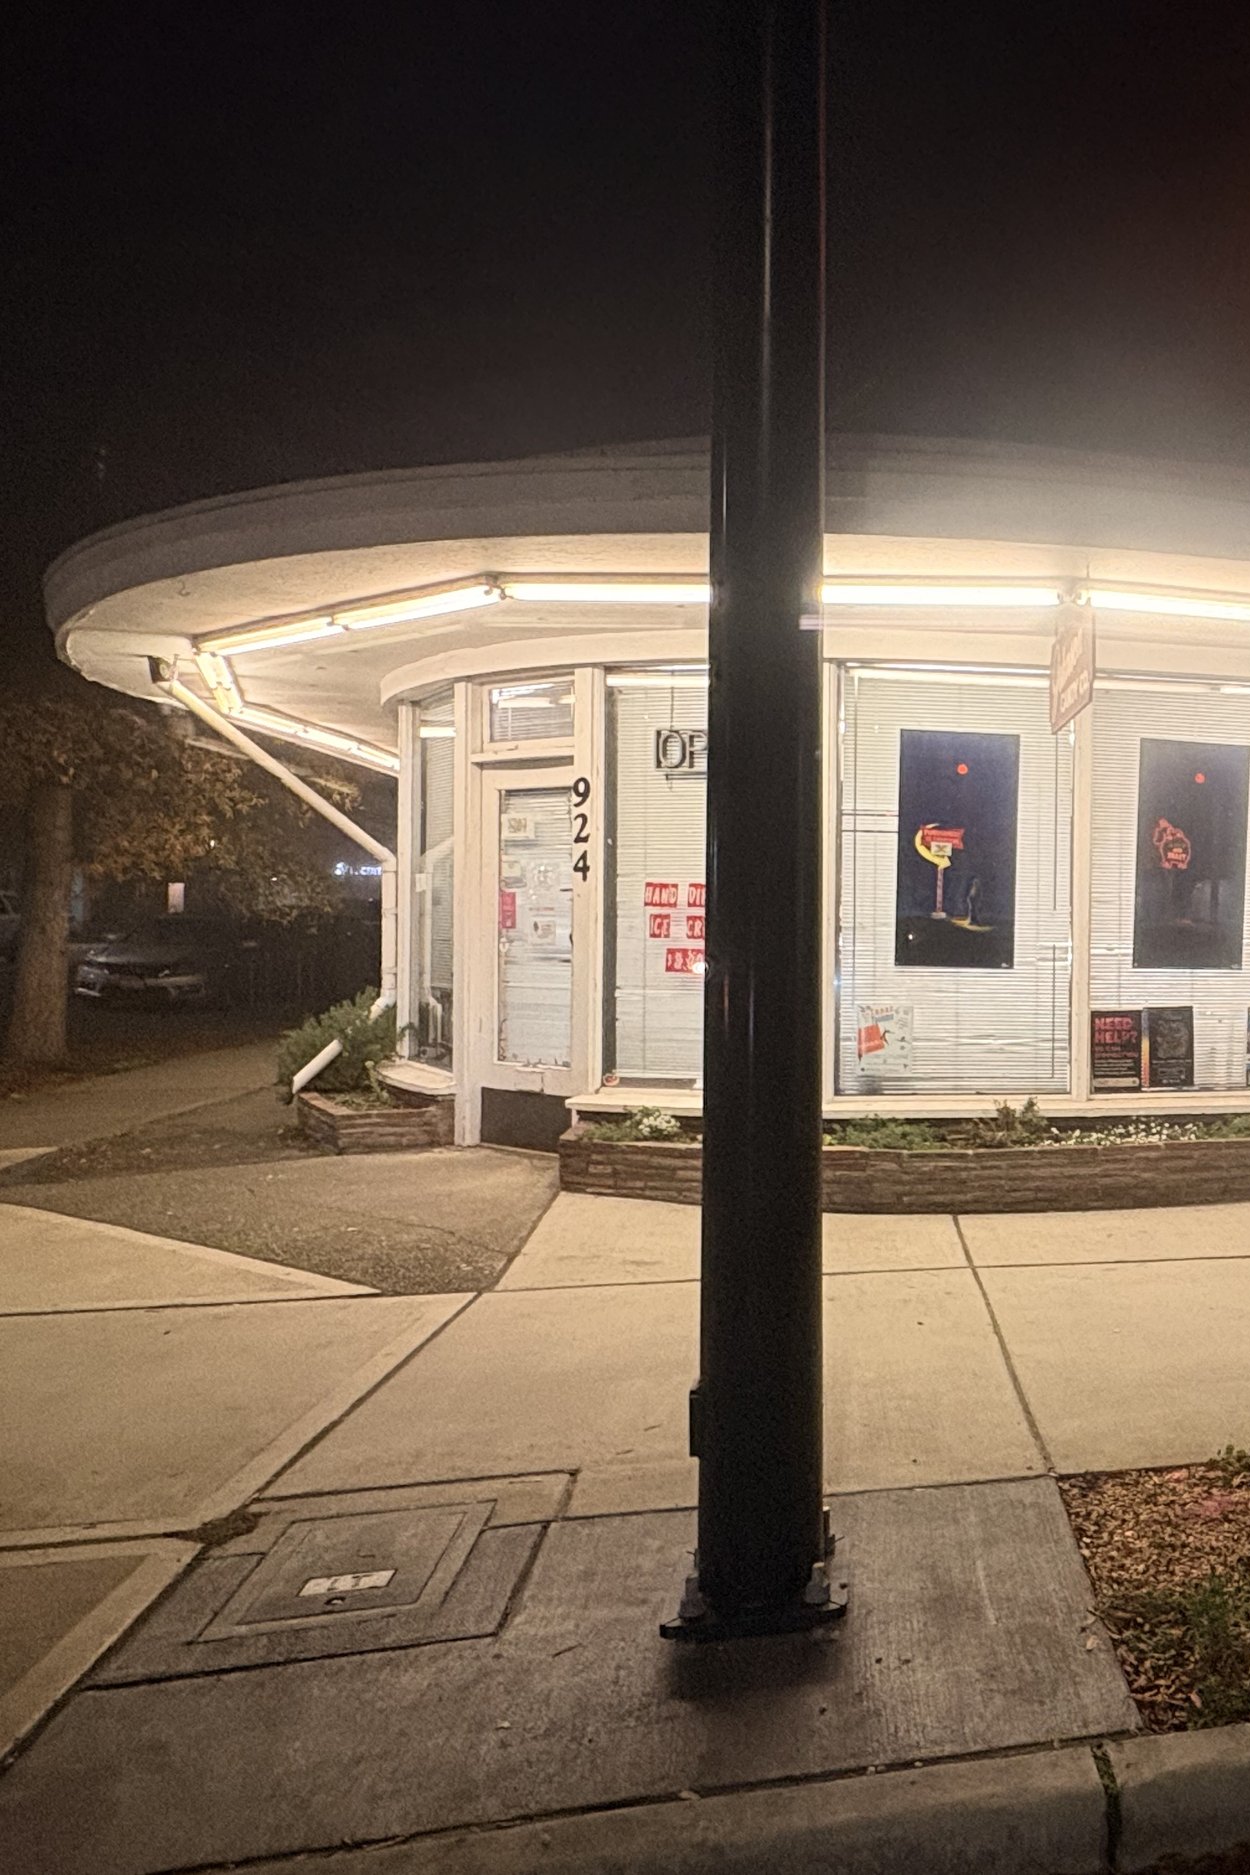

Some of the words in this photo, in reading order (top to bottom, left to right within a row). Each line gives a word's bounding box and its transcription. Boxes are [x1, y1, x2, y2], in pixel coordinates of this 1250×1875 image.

[572, 777, 592, 882] 924
[645, 885, 677, 905] HAND
[650, 916, 670, 938] ICE
[1094, 1017, 1133, 1030] NEED
